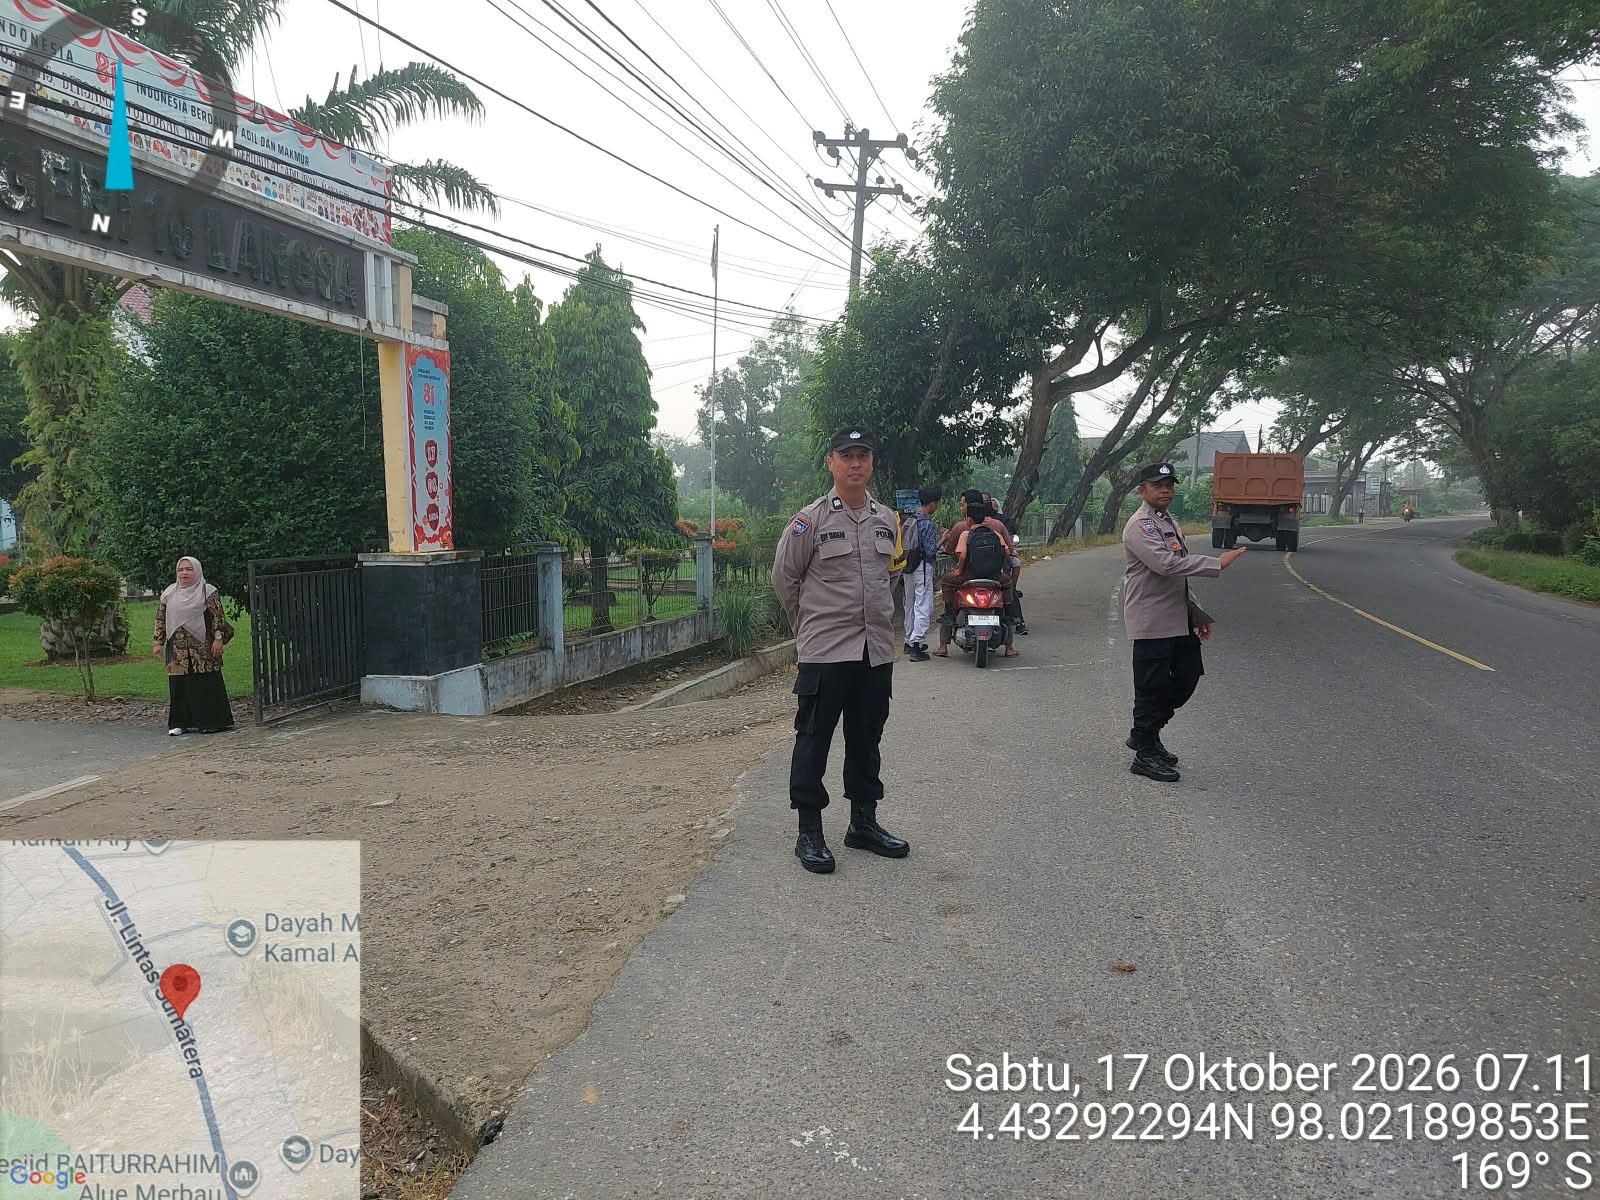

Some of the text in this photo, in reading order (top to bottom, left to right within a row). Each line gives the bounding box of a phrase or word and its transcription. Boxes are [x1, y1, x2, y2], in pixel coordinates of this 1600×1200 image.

[136, 81, 188, 114] INDONESIA
[241, 127, 259, 145] ADIL
[260, 137, 276, 151] DAN
[277, 143, 310, 168] MAKMUR
